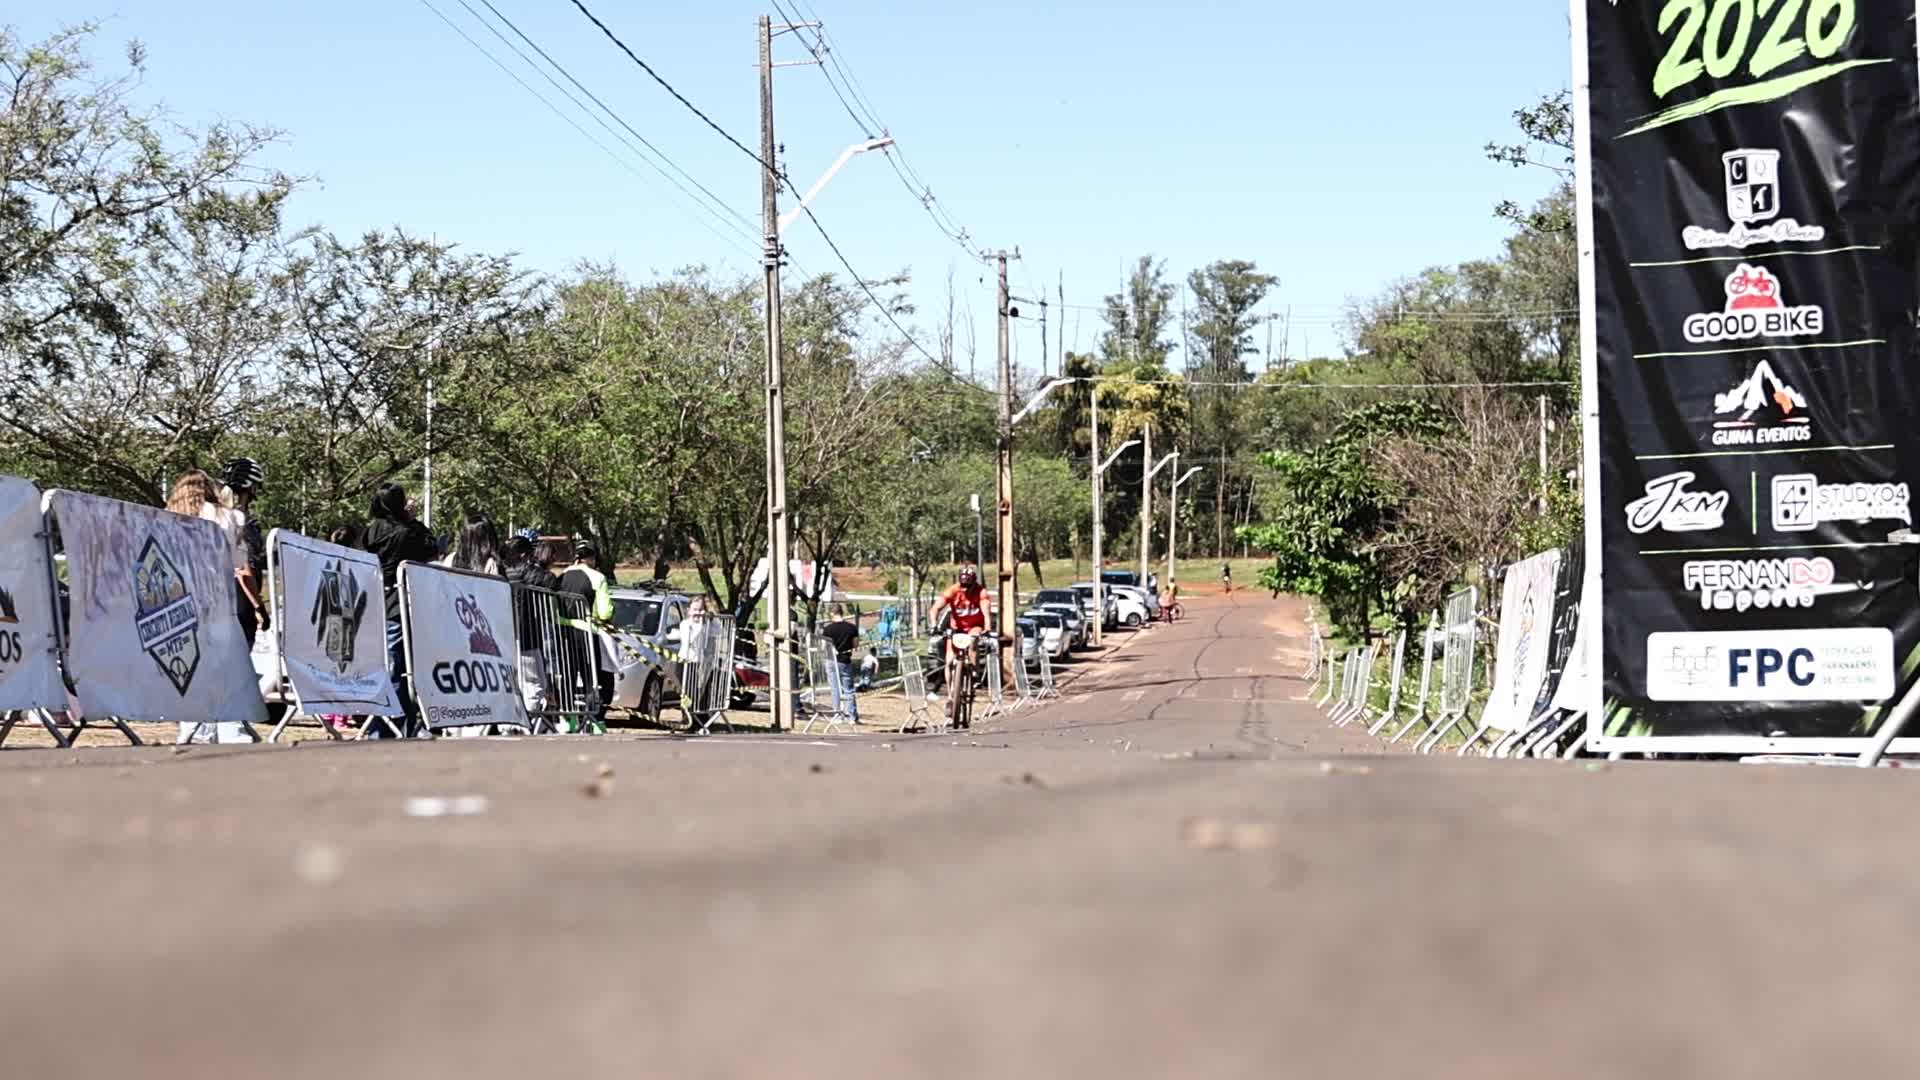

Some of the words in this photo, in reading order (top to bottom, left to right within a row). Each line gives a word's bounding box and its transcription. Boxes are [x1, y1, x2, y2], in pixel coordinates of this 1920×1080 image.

[1652, 0, 1856, 98] 2026
[1688, 313, 1757, 338] GOOD
[1765, 310, 1819, 332] BIKE
[1712, 429, 1754, 445] GUINA
[1756, 425, 1811, 443] EVENTOS
[1631, 476, 1724, 529] JKM
[1687, 560, 1831, 587] FERNANDO
[432, 659, 500, 694] GOOD
[1728, 646, 1816, 687] FPC
